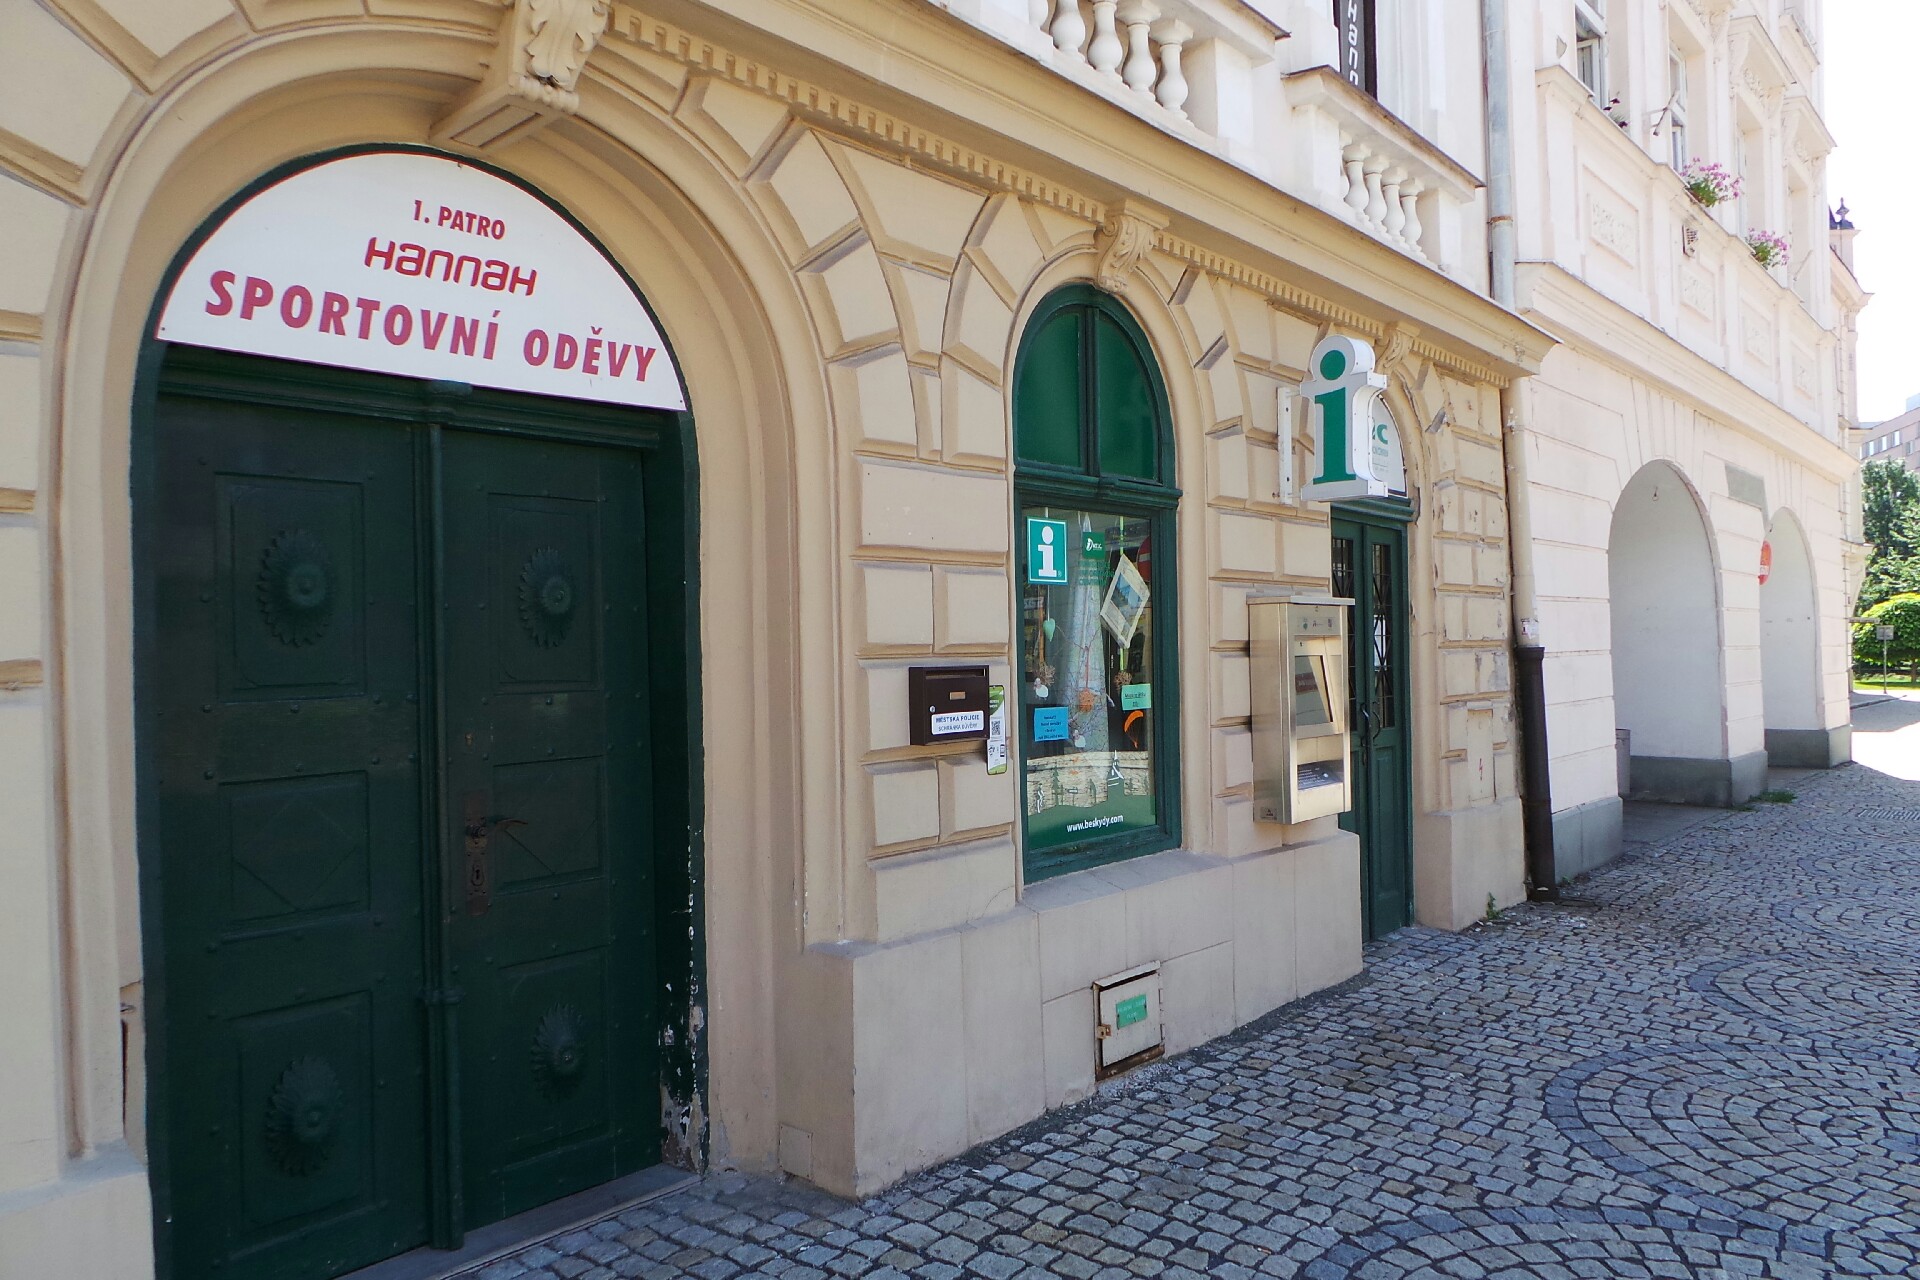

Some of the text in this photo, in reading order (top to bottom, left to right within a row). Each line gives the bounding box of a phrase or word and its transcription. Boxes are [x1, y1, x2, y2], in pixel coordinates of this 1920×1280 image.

[414, 199, 506, 241] 1. PATRO
[205, 269, 657, 383] SPORTOVNÍ ODĚVY
[1066, 814, 1124, 833] www.beskydy.com
